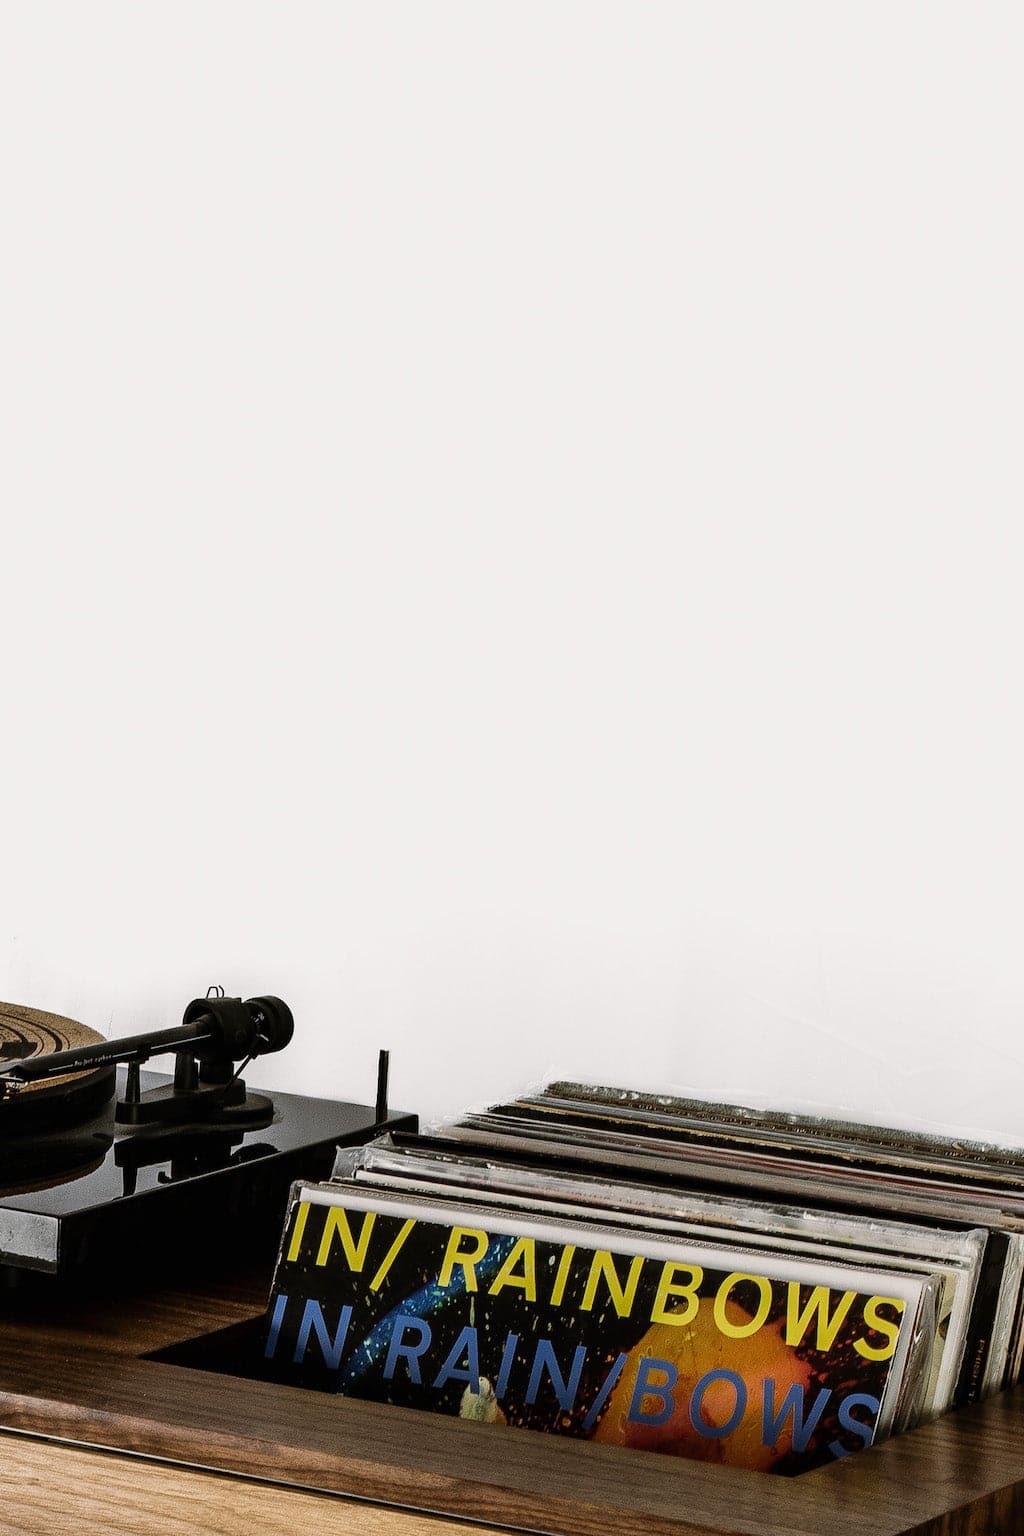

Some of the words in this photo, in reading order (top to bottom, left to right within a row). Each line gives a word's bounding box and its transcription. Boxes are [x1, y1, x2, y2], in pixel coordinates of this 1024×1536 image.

[287, 1203, 417, 1292] IN/
[439, 1228, 907, 1361] RAINBOWS
[263, 1295, 353, 1370] IN
[383, 1315, 880, 1459] RAIN/BOWS
